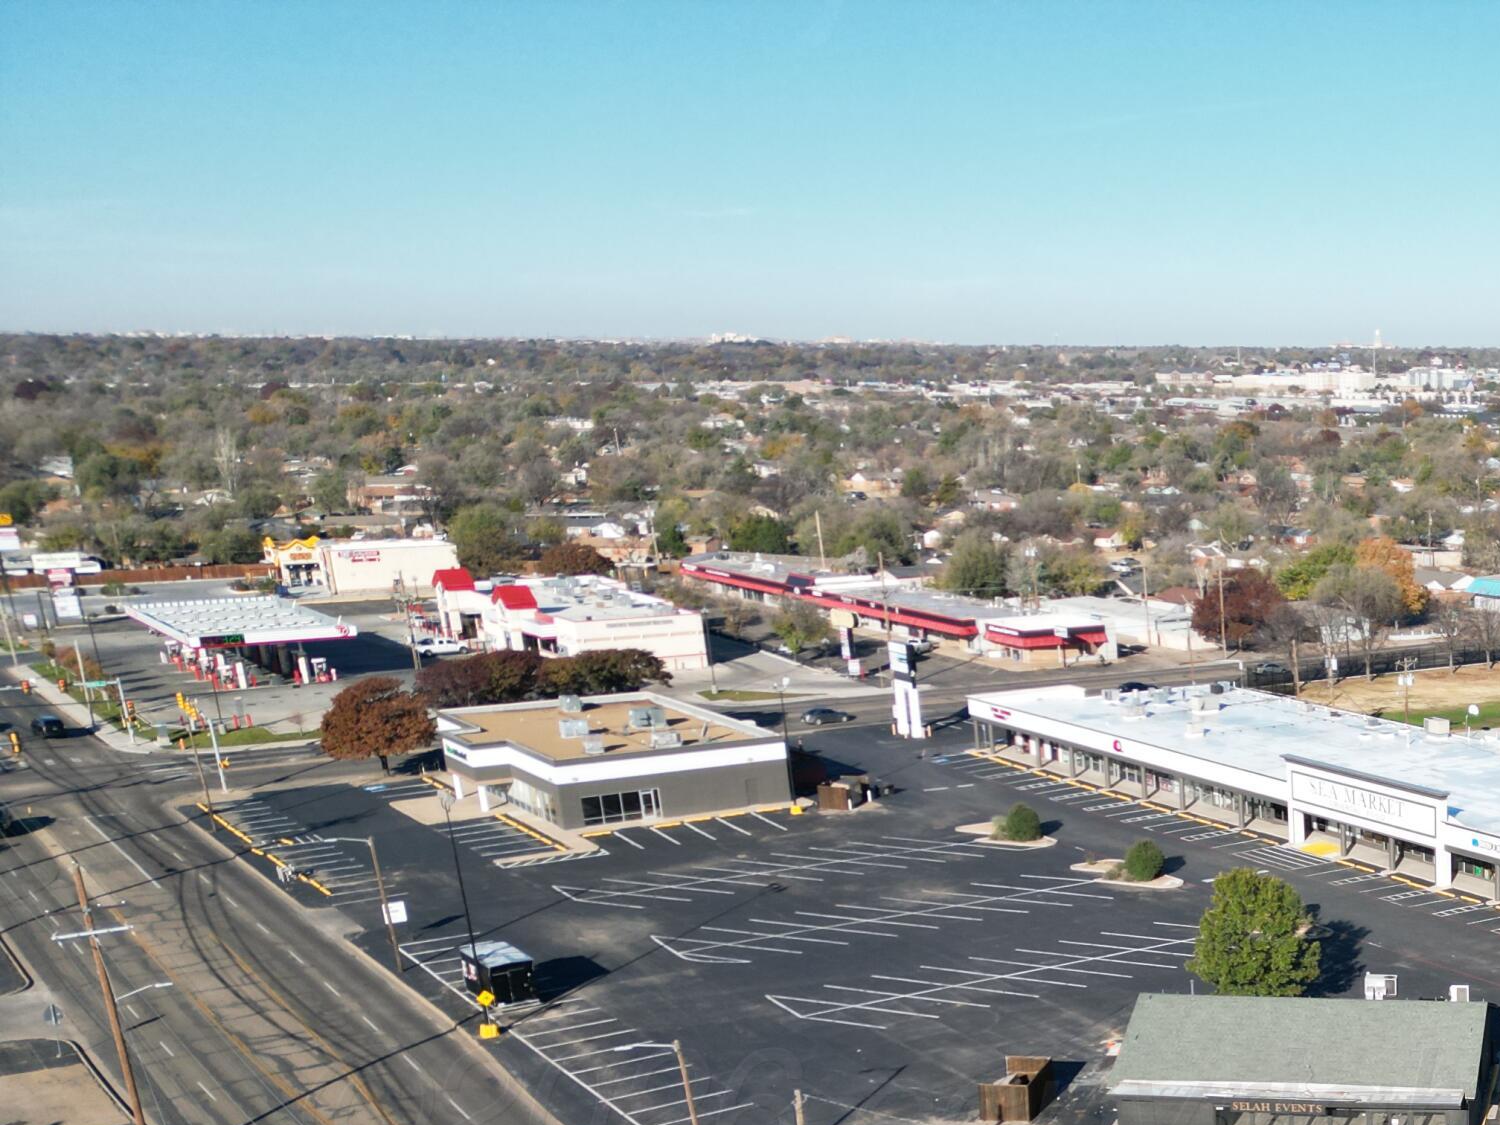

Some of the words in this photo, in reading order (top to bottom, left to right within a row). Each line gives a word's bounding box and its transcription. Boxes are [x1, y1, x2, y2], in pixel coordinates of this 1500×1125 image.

[1309, 780, 1338, 801] SEA
[1343, 787, 1405, 817] MARKET
[1231, 1101, 1270, 1112] SELAH
[1275, 1102, 1323, 1113] EVENTS
